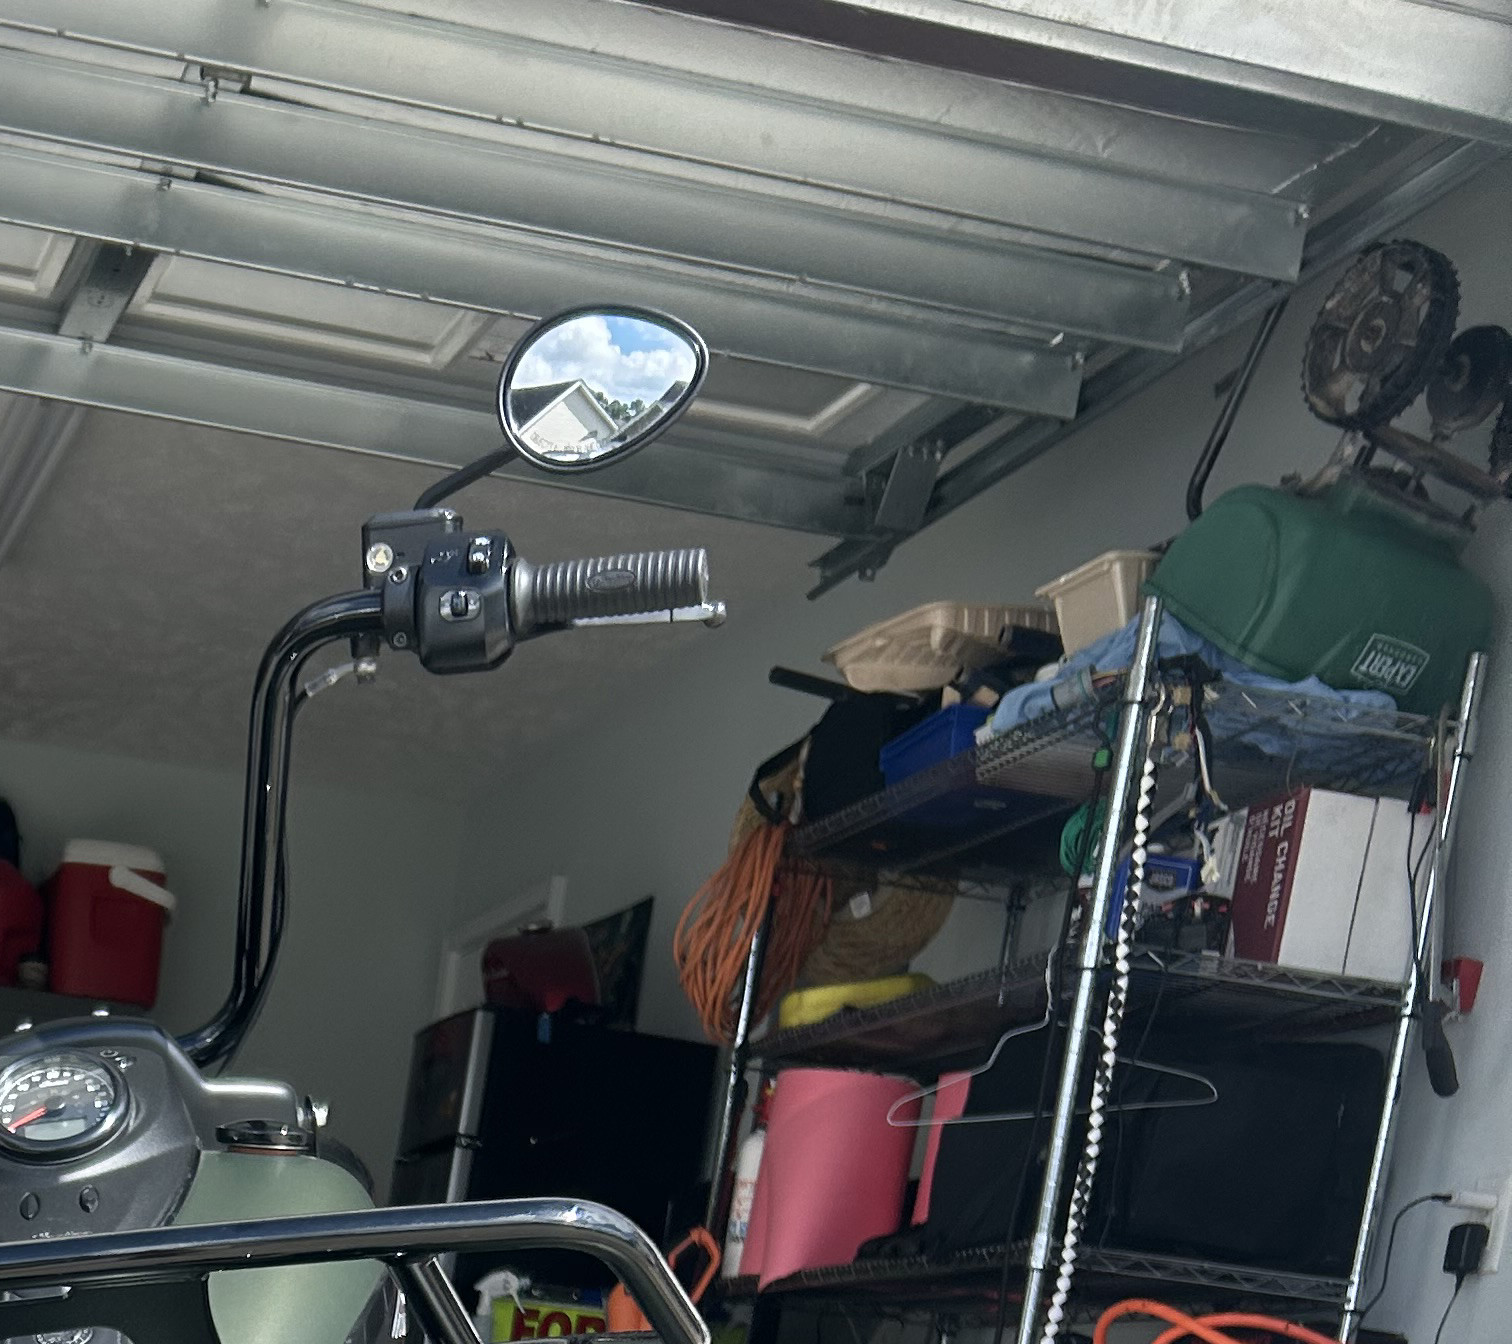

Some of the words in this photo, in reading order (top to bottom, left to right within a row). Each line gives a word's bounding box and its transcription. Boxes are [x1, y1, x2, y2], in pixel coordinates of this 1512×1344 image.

[1358, 650, 1418, 688] EXPERT
[1268, 803, 1284, 839] KIT
[1279, 798, 1296, 838] OIL
[1263, 840, 1289, 931] CHANGE
